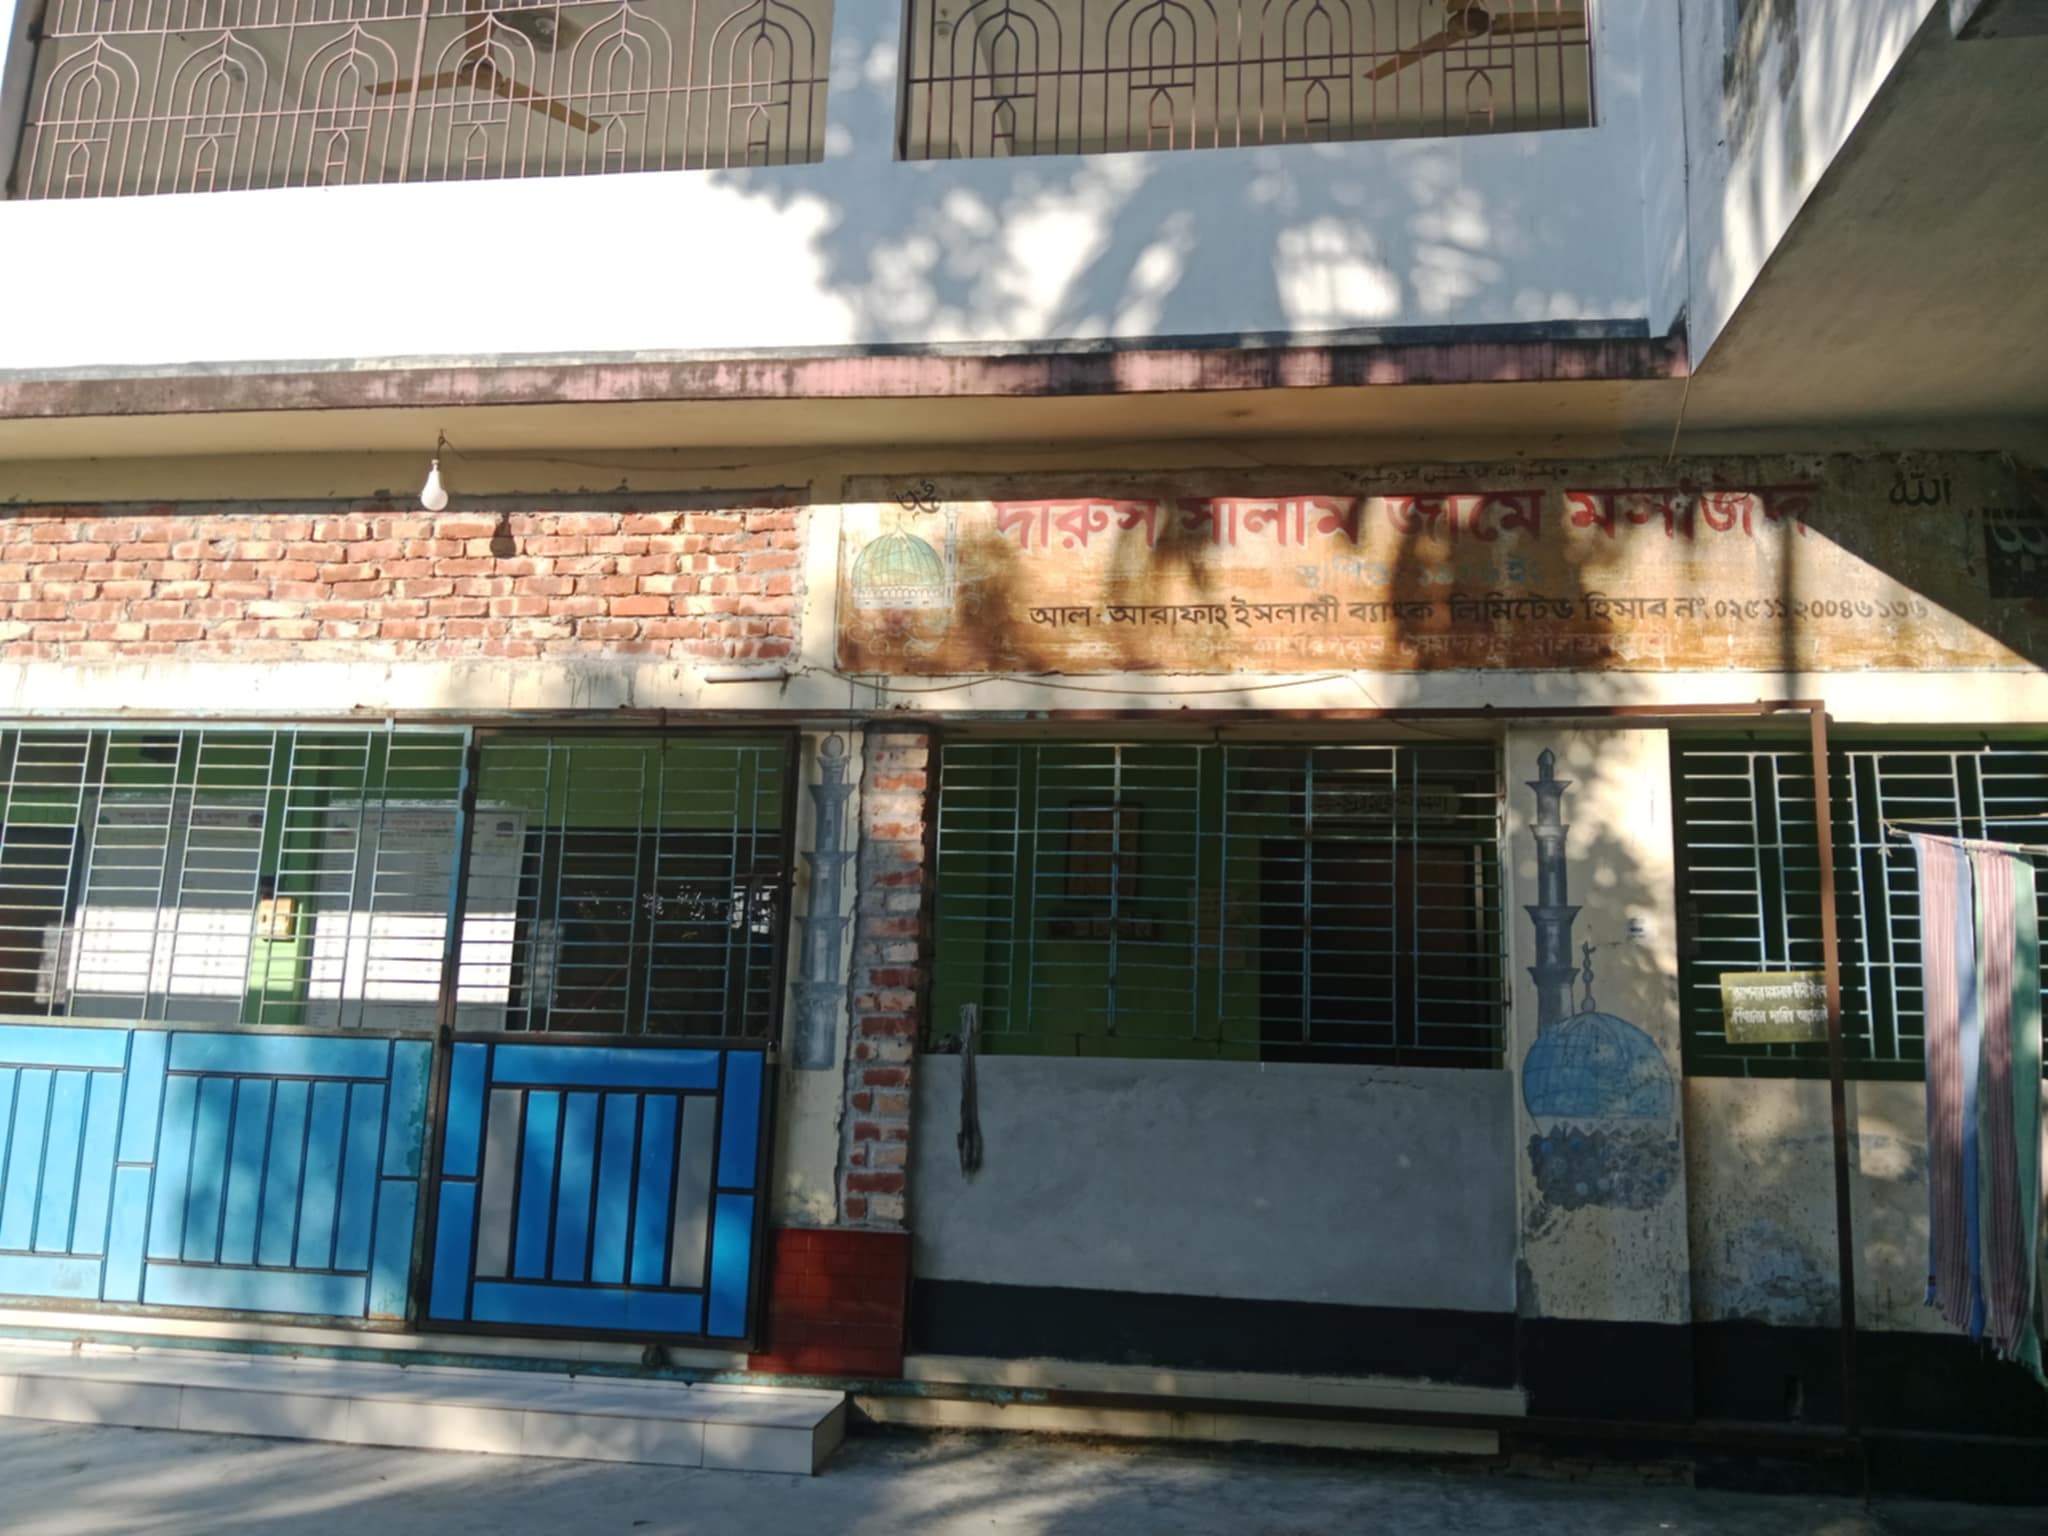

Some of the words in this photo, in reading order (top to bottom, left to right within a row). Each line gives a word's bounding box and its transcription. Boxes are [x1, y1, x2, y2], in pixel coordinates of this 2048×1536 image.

[991, 497, 1159, 552] দারুস
[1176, 493, 1360, 549] সালাম
[1385, 488, 1546, 543] জামে
[1230, 595, 1342, 629] ইসলামী
[1447, 591, 1575, 623] লিমিটেড
[1580, 592, 1668, 624] হিসাব
